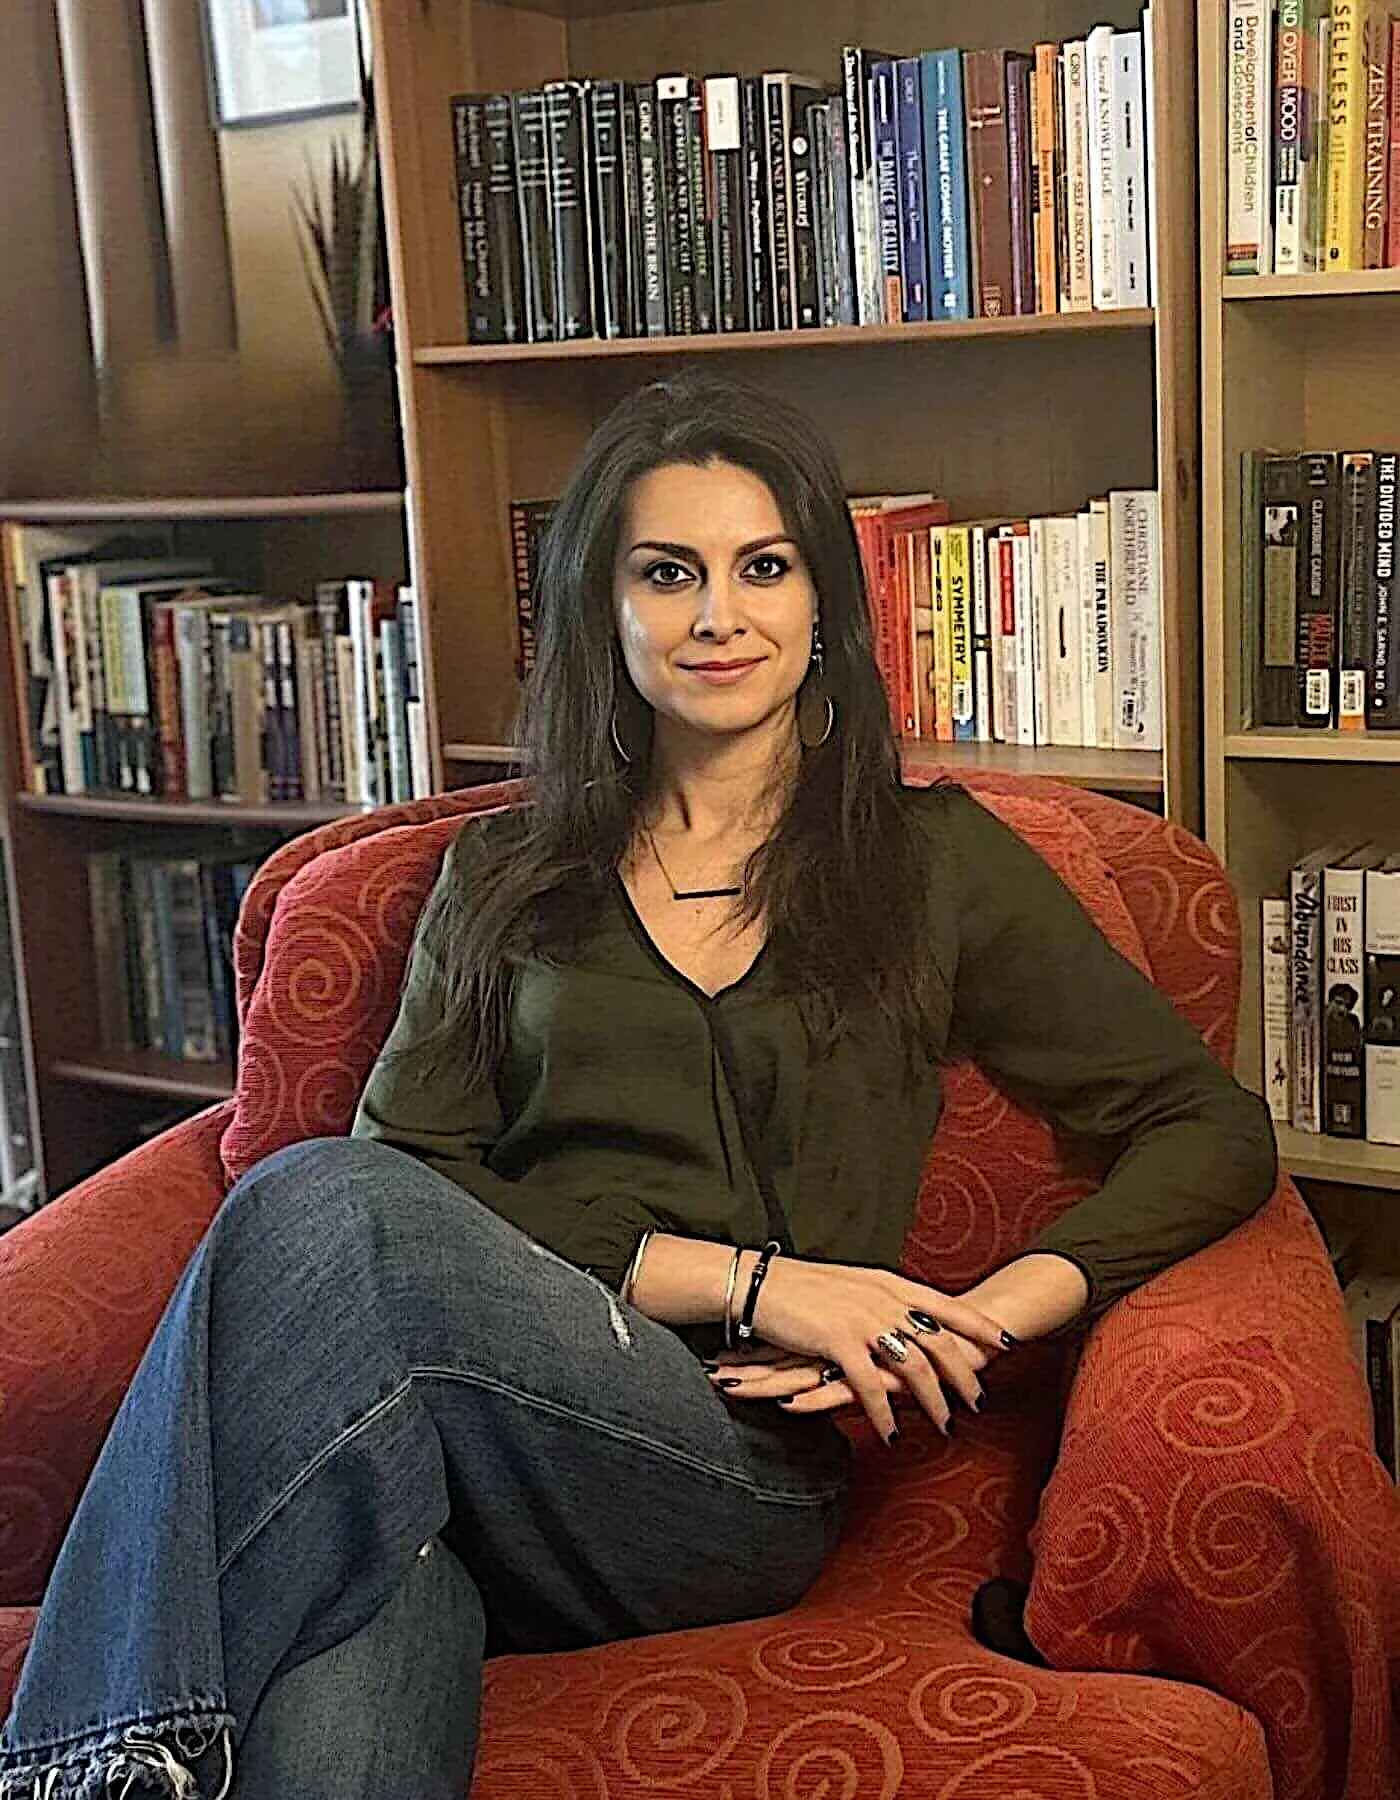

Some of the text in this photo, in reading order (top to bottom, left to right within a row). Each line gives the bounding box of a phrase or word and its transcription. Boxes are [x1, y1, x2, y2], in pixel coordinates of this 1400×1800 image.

[1282, 32, 1298, 82] OVER
[1331, 5, 1350, 126] SELFLESS
[1231, 18, 1247, 154] and Adolescents
[771, 119, 783, 151] EGO
[937, 107, 949, 131] THE
[1243, 16, 1260, 212] Development of Children
[1279, 87, 1298, 141] MOOD
[774, 155, 785, 188] AND
[938, 134, 950, 171] GREAT
[1100, 98, 1114, 198] KNOWLEDGE
[1365, 63, 1386, 231] ZEN TRAINING
[674, 103, 693, 274] COSMOS AND PSYCHE
[692, 135, 708, 276] PSYCHEDELIC JUSTICE
[879, 159, 896, 201] DANCE
[940, 174, 953, 223] COSMIC
[643, 157, 660, 301] BEYOND THE BRAIN
[775, 192, 789, 270] ARCHETYPE
[882, 219, 899, 272] REALITY
[942, 226, 955, 277] MOTHER
[476, 240, 490, 297] Change
[1376, 455, 1396, 578] THE DIVIDED MIND
[1137, 508, 1151, 594] CHRISTIANE
[952, 576, 967, 665] SYMMETRY
[1095, 559, 1110, 673] THE PARADOXICON
[1376, 583, 1389, 614] JOHN
[1327, 895, 1357, 913] FIRST
[1336, 917, 1348, 933] IN
[1292, 892, 1319, 1007] Abundance
[1327, 958, 1359, 975] CLASS
[1333, 936, 1352, 953] HIS
